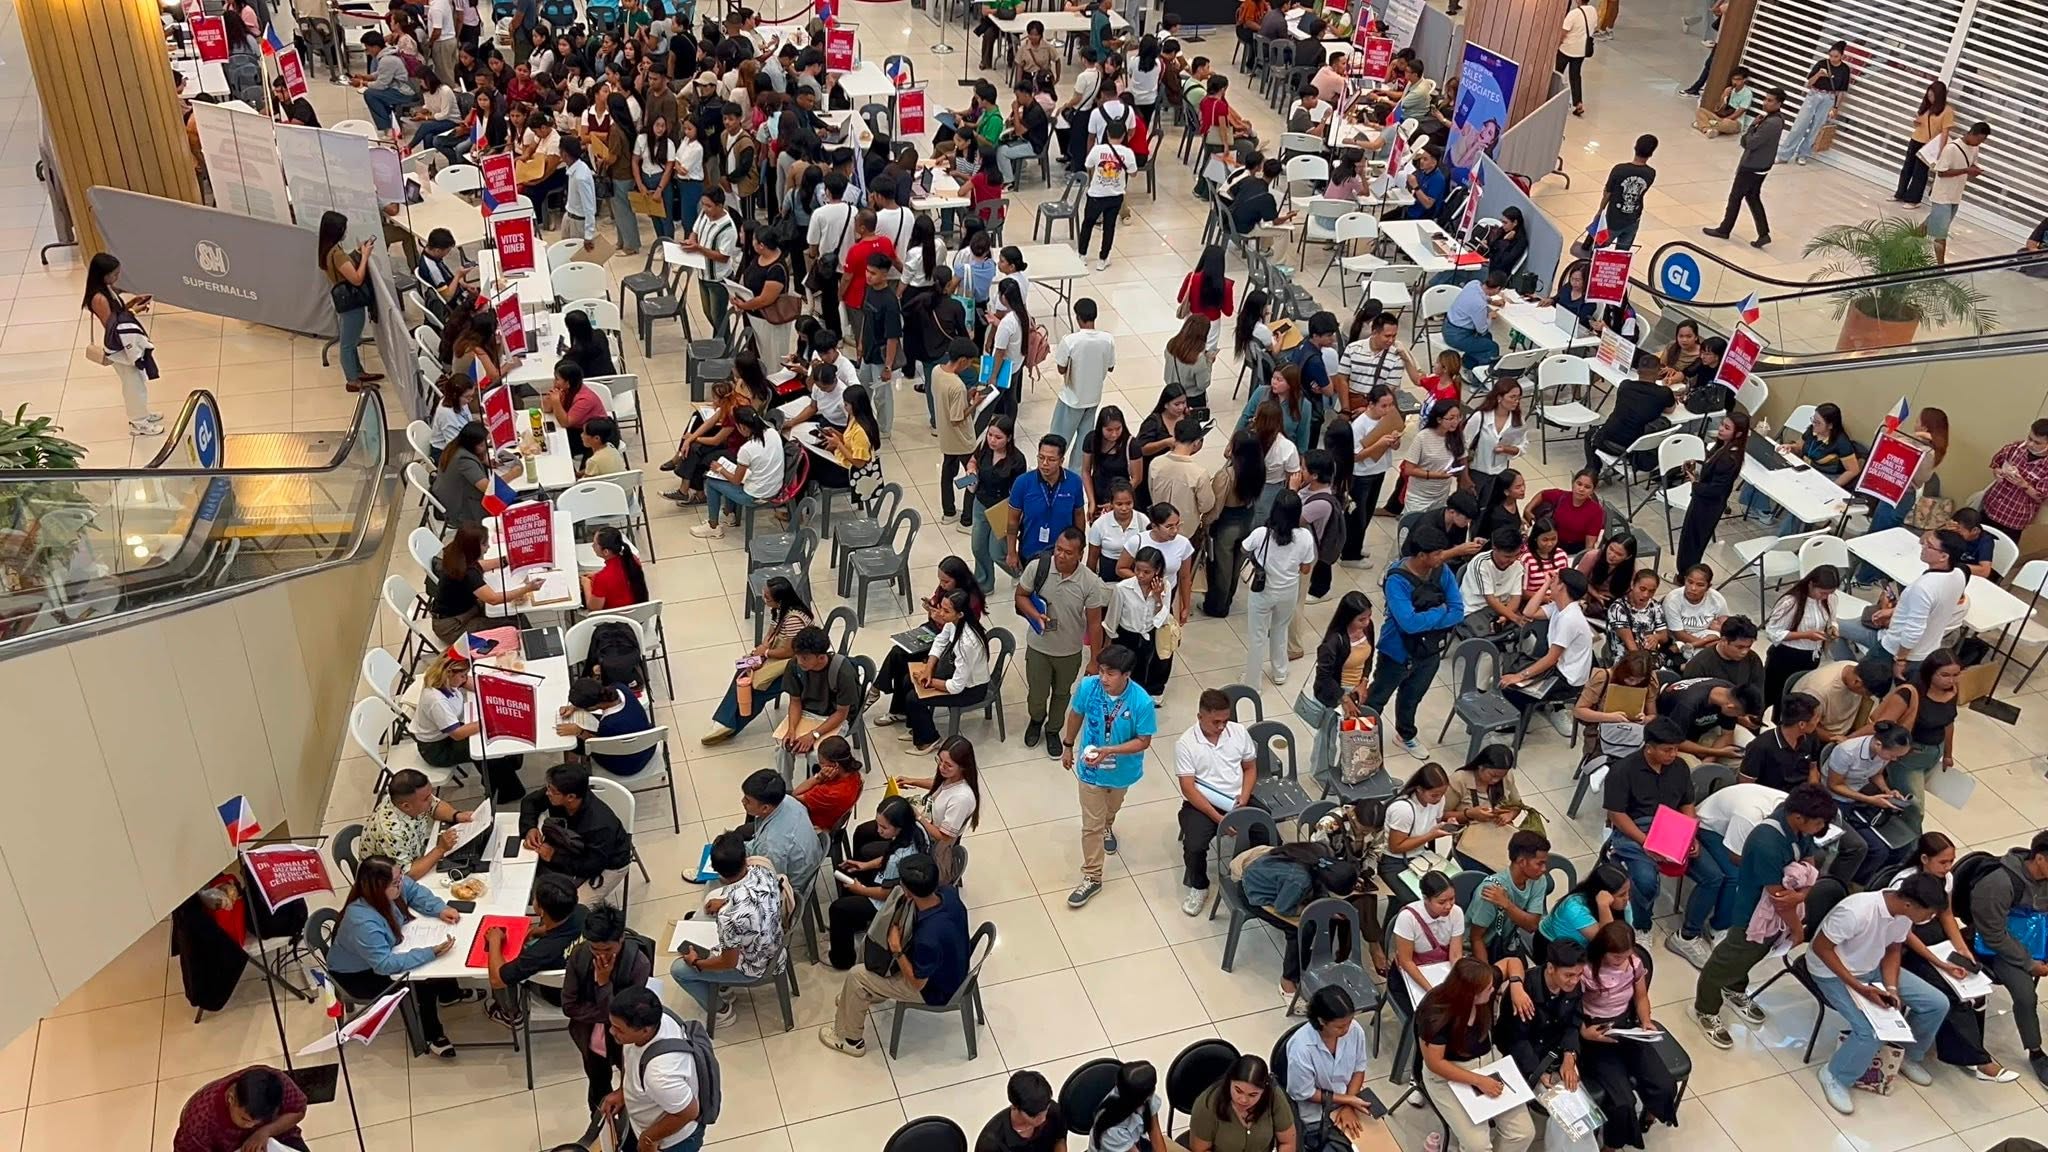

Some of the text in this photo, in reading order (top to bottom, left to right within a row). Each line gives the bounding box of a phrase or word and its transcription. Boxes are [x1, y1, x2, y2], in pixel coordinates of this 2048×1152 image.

[1464, 66, 1482, 83] SALES
[1460, 77, 1500, 104] ASSOCIATES
[501, 233, 524, 244] VITO'S
[504, 244, 525, 254] DINER
[198, 244, 226, 272] SM
[1668, 265, 1692, 292] GL
[182, 276, 258, 300] SUPERMALLS
[198, 420, 212, 452] GL
[1880, 458, 1905, 472] ANALYST
[1886, 453, 1904, 466] CYBER
[1868, 468, 1896, 484] SOLUTIONS
[1872, 461, 1908, 480] TECHNOLOGIES
[508, 518, 546, 534] WOMEN FOR
[514, 512, 540, 525] NEGROS
[509, 527, 546, 542] TOMORROW
[508, 535, 548, 550] FOUNDATION
[522, 545, 534, 554] INC.
[486, 696, 530, 712] NGN GRAN
[496, 706, 524, 719] HOTEL
[272, 865, 310, 873] GUZMAN
[274, 860, 308, 868] RONALD
[274, 870, 311, 879] MEDICAL
[270, 877, 302, 888] CENTER
